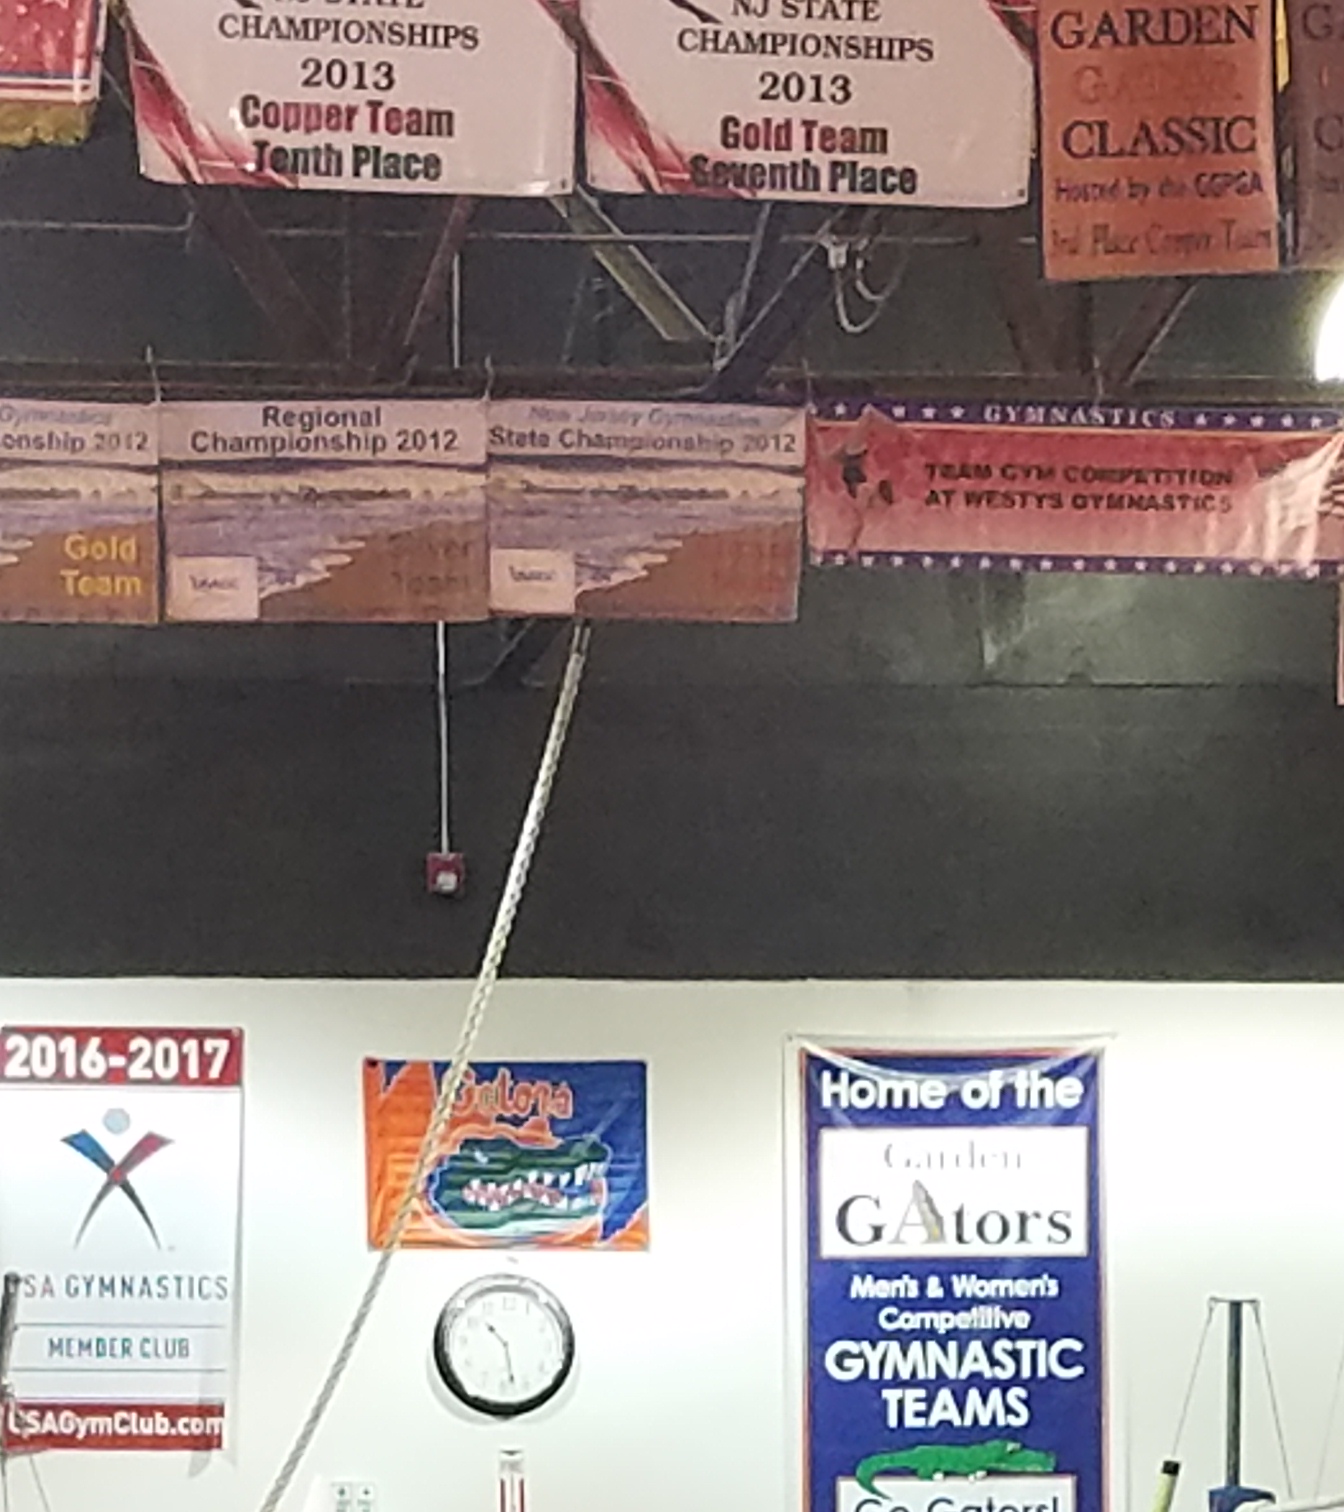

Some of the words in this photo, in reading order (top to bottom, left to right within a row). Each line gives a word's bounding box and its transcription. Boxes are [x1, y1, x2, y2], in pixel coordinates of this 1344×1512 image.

[780, 0, 882, 23] STATE
[1051, 5, 1258, 49] GARDEN
[218, 13, 480, 50] CHAMPIONSHIPS
[677, 28, 934, 62] CHAMPIONSHIPS
[301, 57, 396, 91] 2013
[759, 71, 852, 104] 2013
[240, 94, 359, 135] Copper
[366, 99, 455, 137] Team
[720, 115, 793, 151] Gold
[801, 120, 888, 154] Team
[1062, 115, 1258, 159] CLASSIC
[252, 140, 343, 178] Tenth
[352, 144, 442, 181] Place
[689, 154, 820, 191] Seventh
[829, 160, 917, 195] Place
[1055, 177, 1120, 202] Hosted
[1128, 177, 1150, 206] by
[262, 405, 382, 433] Regional
[984, 404, 1176, 428] GYMNASTICS
[94, 430, 149, 451] 2012
[190, 430, 387, 456] Championship
[396, 429, 459, 452] 2012
[489, 424, 551, 449] State
[558, 427, 734, 456] Championship
[743, 432, 796, 453] 2012
[924, 462, 994, 482] TEAM
[1000, 463, 1055, 482] GYM
[1063, 464, 1235, 486] COMPETITION
[924, 489, 957, 510] AT
[963, 489, 1064, 511] WESTYS
[1070, 493, 1234, 514] GYMNASTICS
[64, 532, 138, 562] Gold
[59, 569, 143, 597] Team
[4, 1035, 230, 1079] 2016-2017
[820, 1070, 946, 1109] Home
[960, 1070, 1004, 1109] of
[1012, 1070, 1085, 1109] the
[884, 1140, 1022, 1170] Garden
[65, 1274, 229, 1300] GYMNASTICS
[850, 1274, 919, 1299] Men's
[927, 1276, 944, 1298] &
[951, 1274, 1059, 1299] Women's
[878, 1306, 1031, 1333] Competitive
[48, 1337, 133, 1358] MEMBER
[139, 1337, 190, 1358] CLUB
[824, 1337, 1085, 1382] GYMNASTIC
[881, 1386, 1030, 1428] TEAMS
